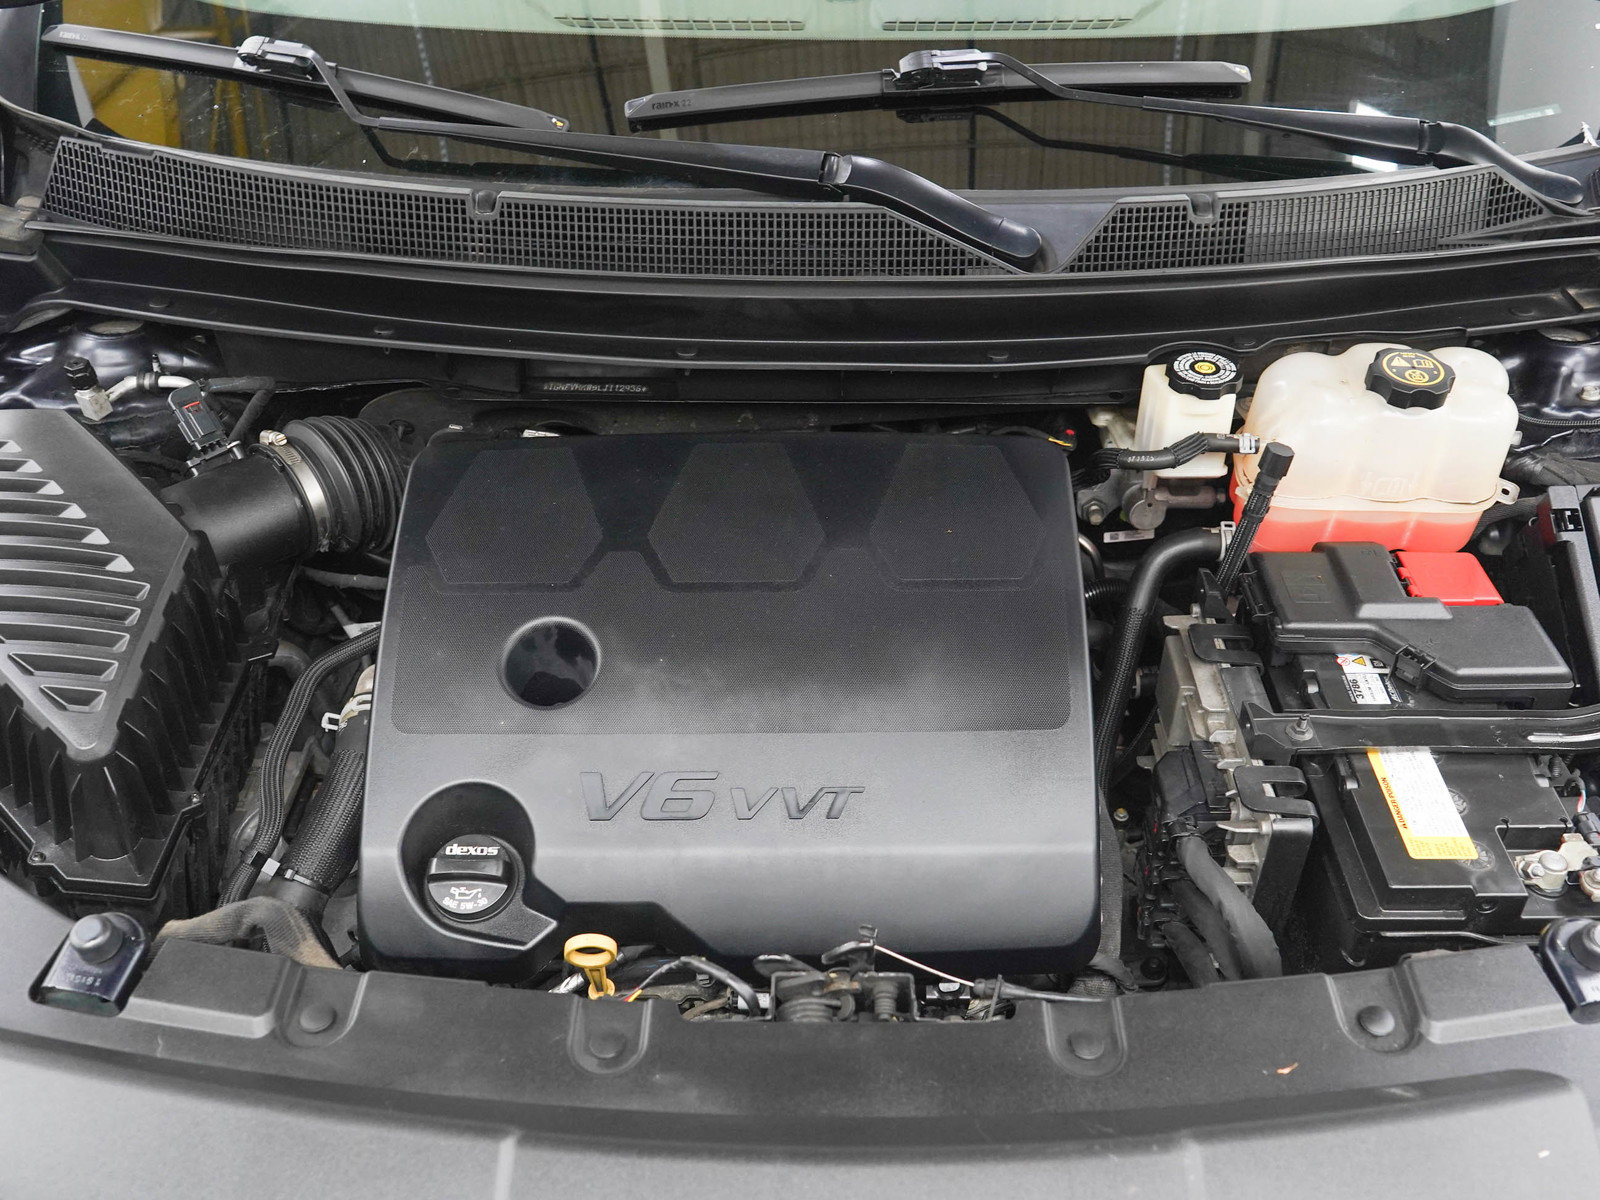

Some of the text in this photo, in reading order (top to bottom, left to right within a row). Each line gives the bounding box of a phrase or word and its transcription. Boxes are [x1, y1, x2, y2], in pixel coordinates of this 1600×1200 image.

[1349, 678, 1364, 700] 3786
[579, 771, 866, 821] V6 VVT
[1380, 776, 1394, 799] POISON
[445, 843, 500, 856] dexos
[442, 896, 488, 910] SAE 5W-30
